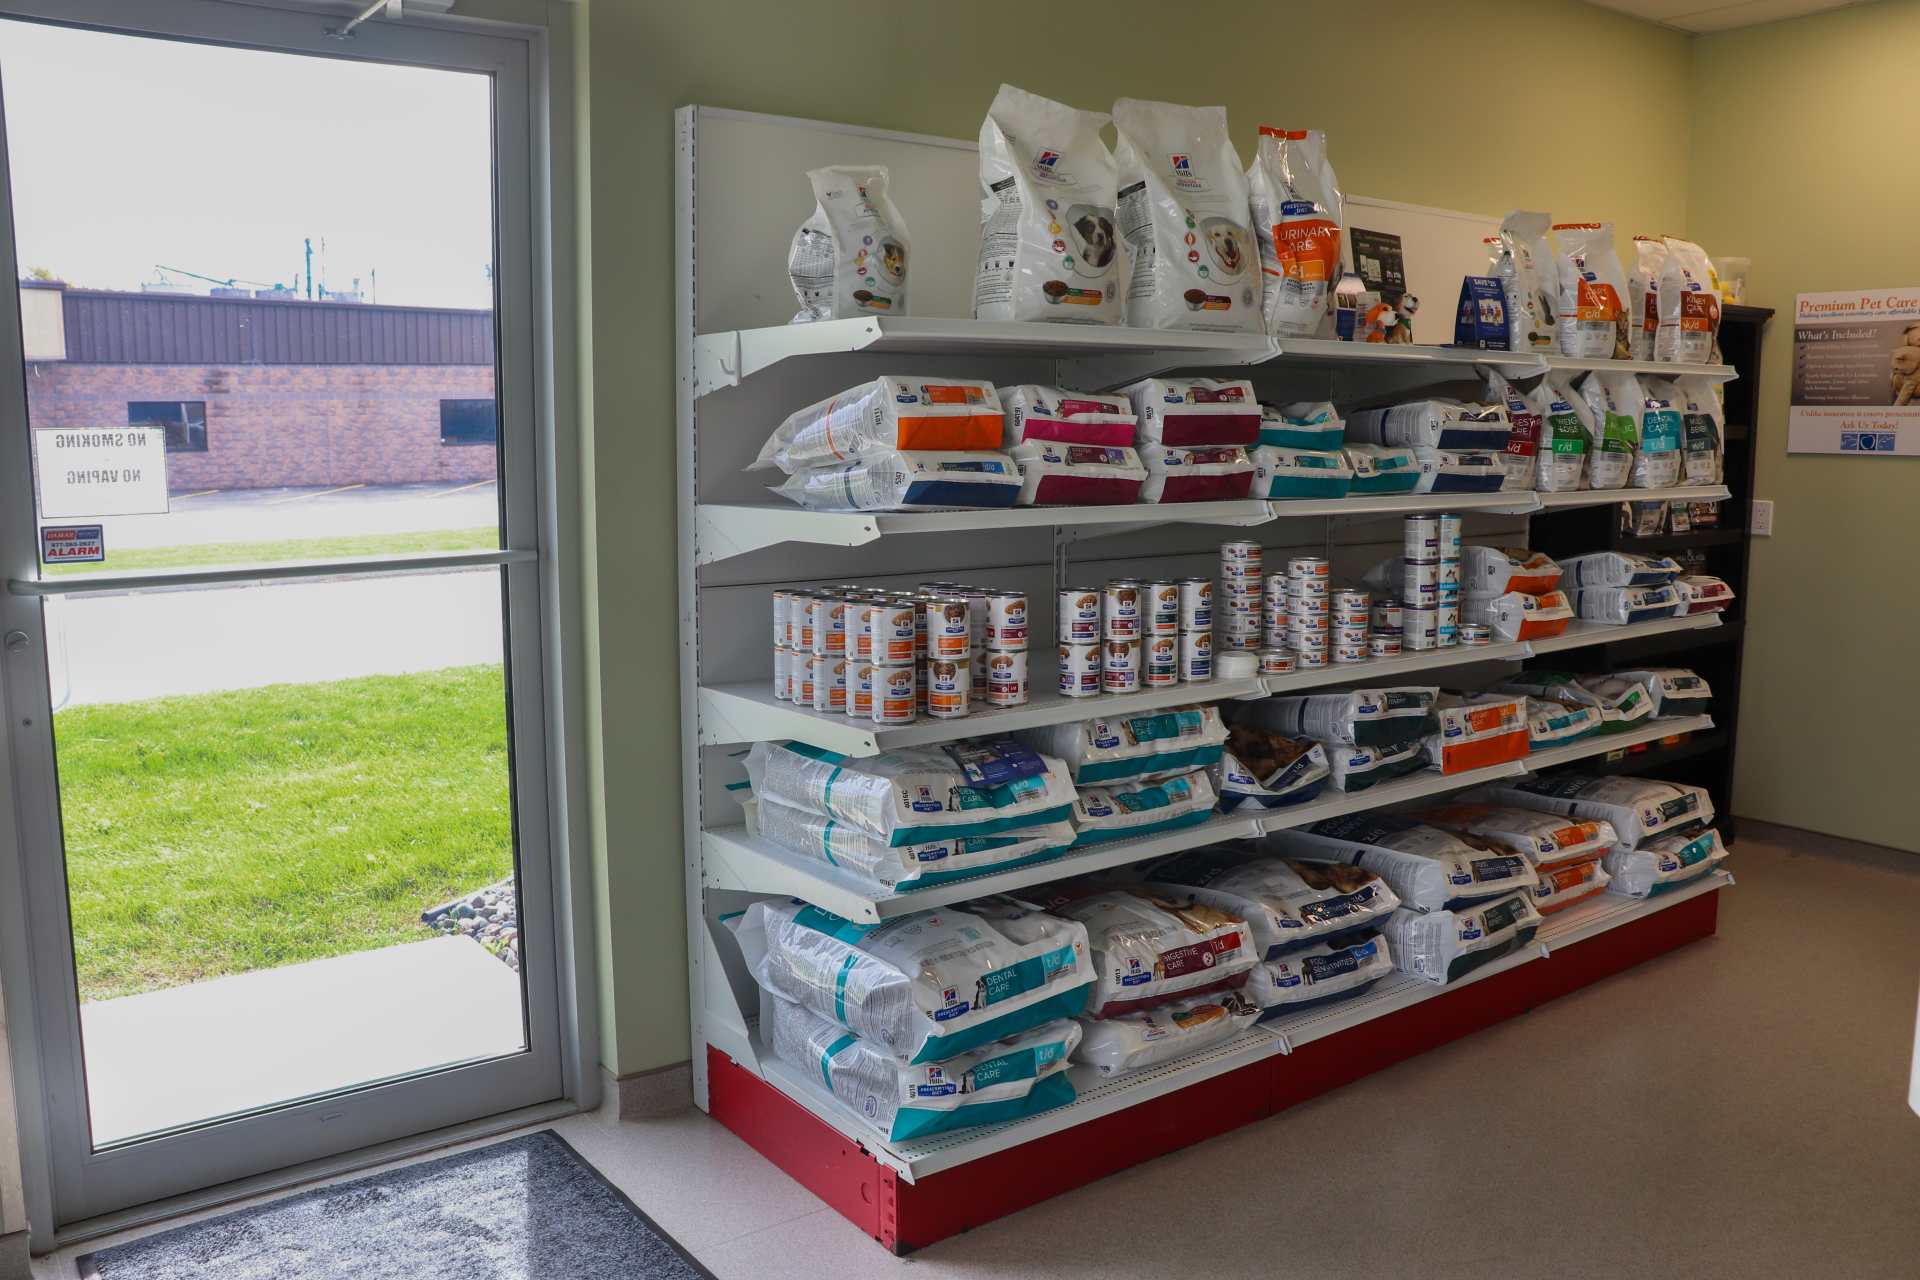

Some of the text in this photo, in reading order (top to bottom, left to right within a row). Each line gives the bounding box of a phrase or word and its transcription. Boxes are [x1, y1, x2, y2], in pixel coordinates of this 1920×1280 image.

[1800, 296, 1918, 313] Premium Pet Care
[1799, 330, 1829, 340] What's
[48, 547, 99, 556] ALARM
[987, 968, 1017, 986] DENTAL
[988, 983, 1009, 995] CARE
[976, 1070, 1001, 1081] CARE
